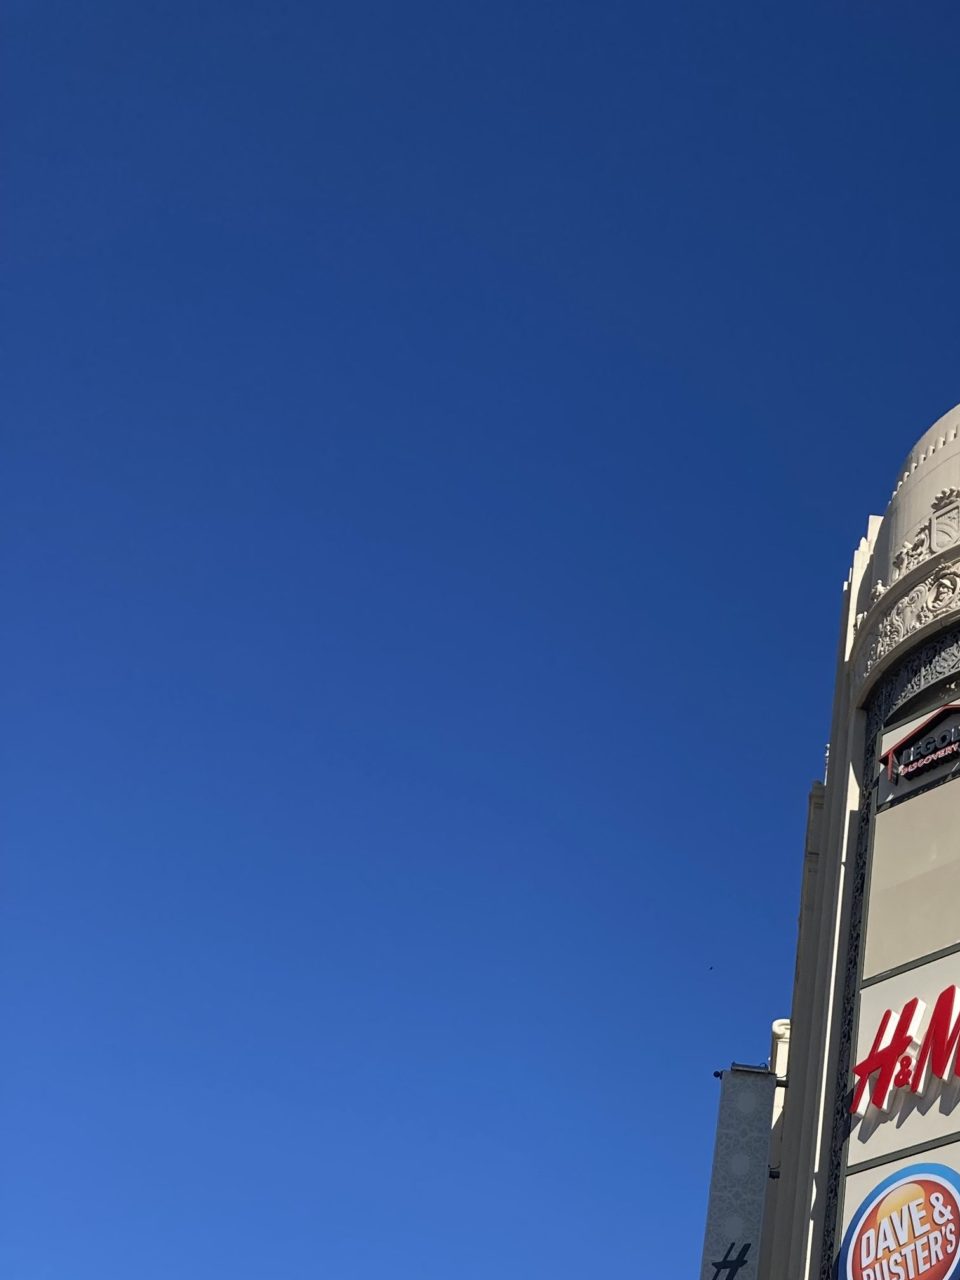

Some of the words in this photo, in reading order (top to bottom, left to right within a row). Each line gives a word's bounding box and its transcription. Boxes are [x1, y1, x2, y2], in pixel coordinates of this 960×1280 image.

[900, 742, 960, 776] DISCOVERY
[860, 1200, 930, 1269] DAVE
[930, 1191, 954, 1233] &
